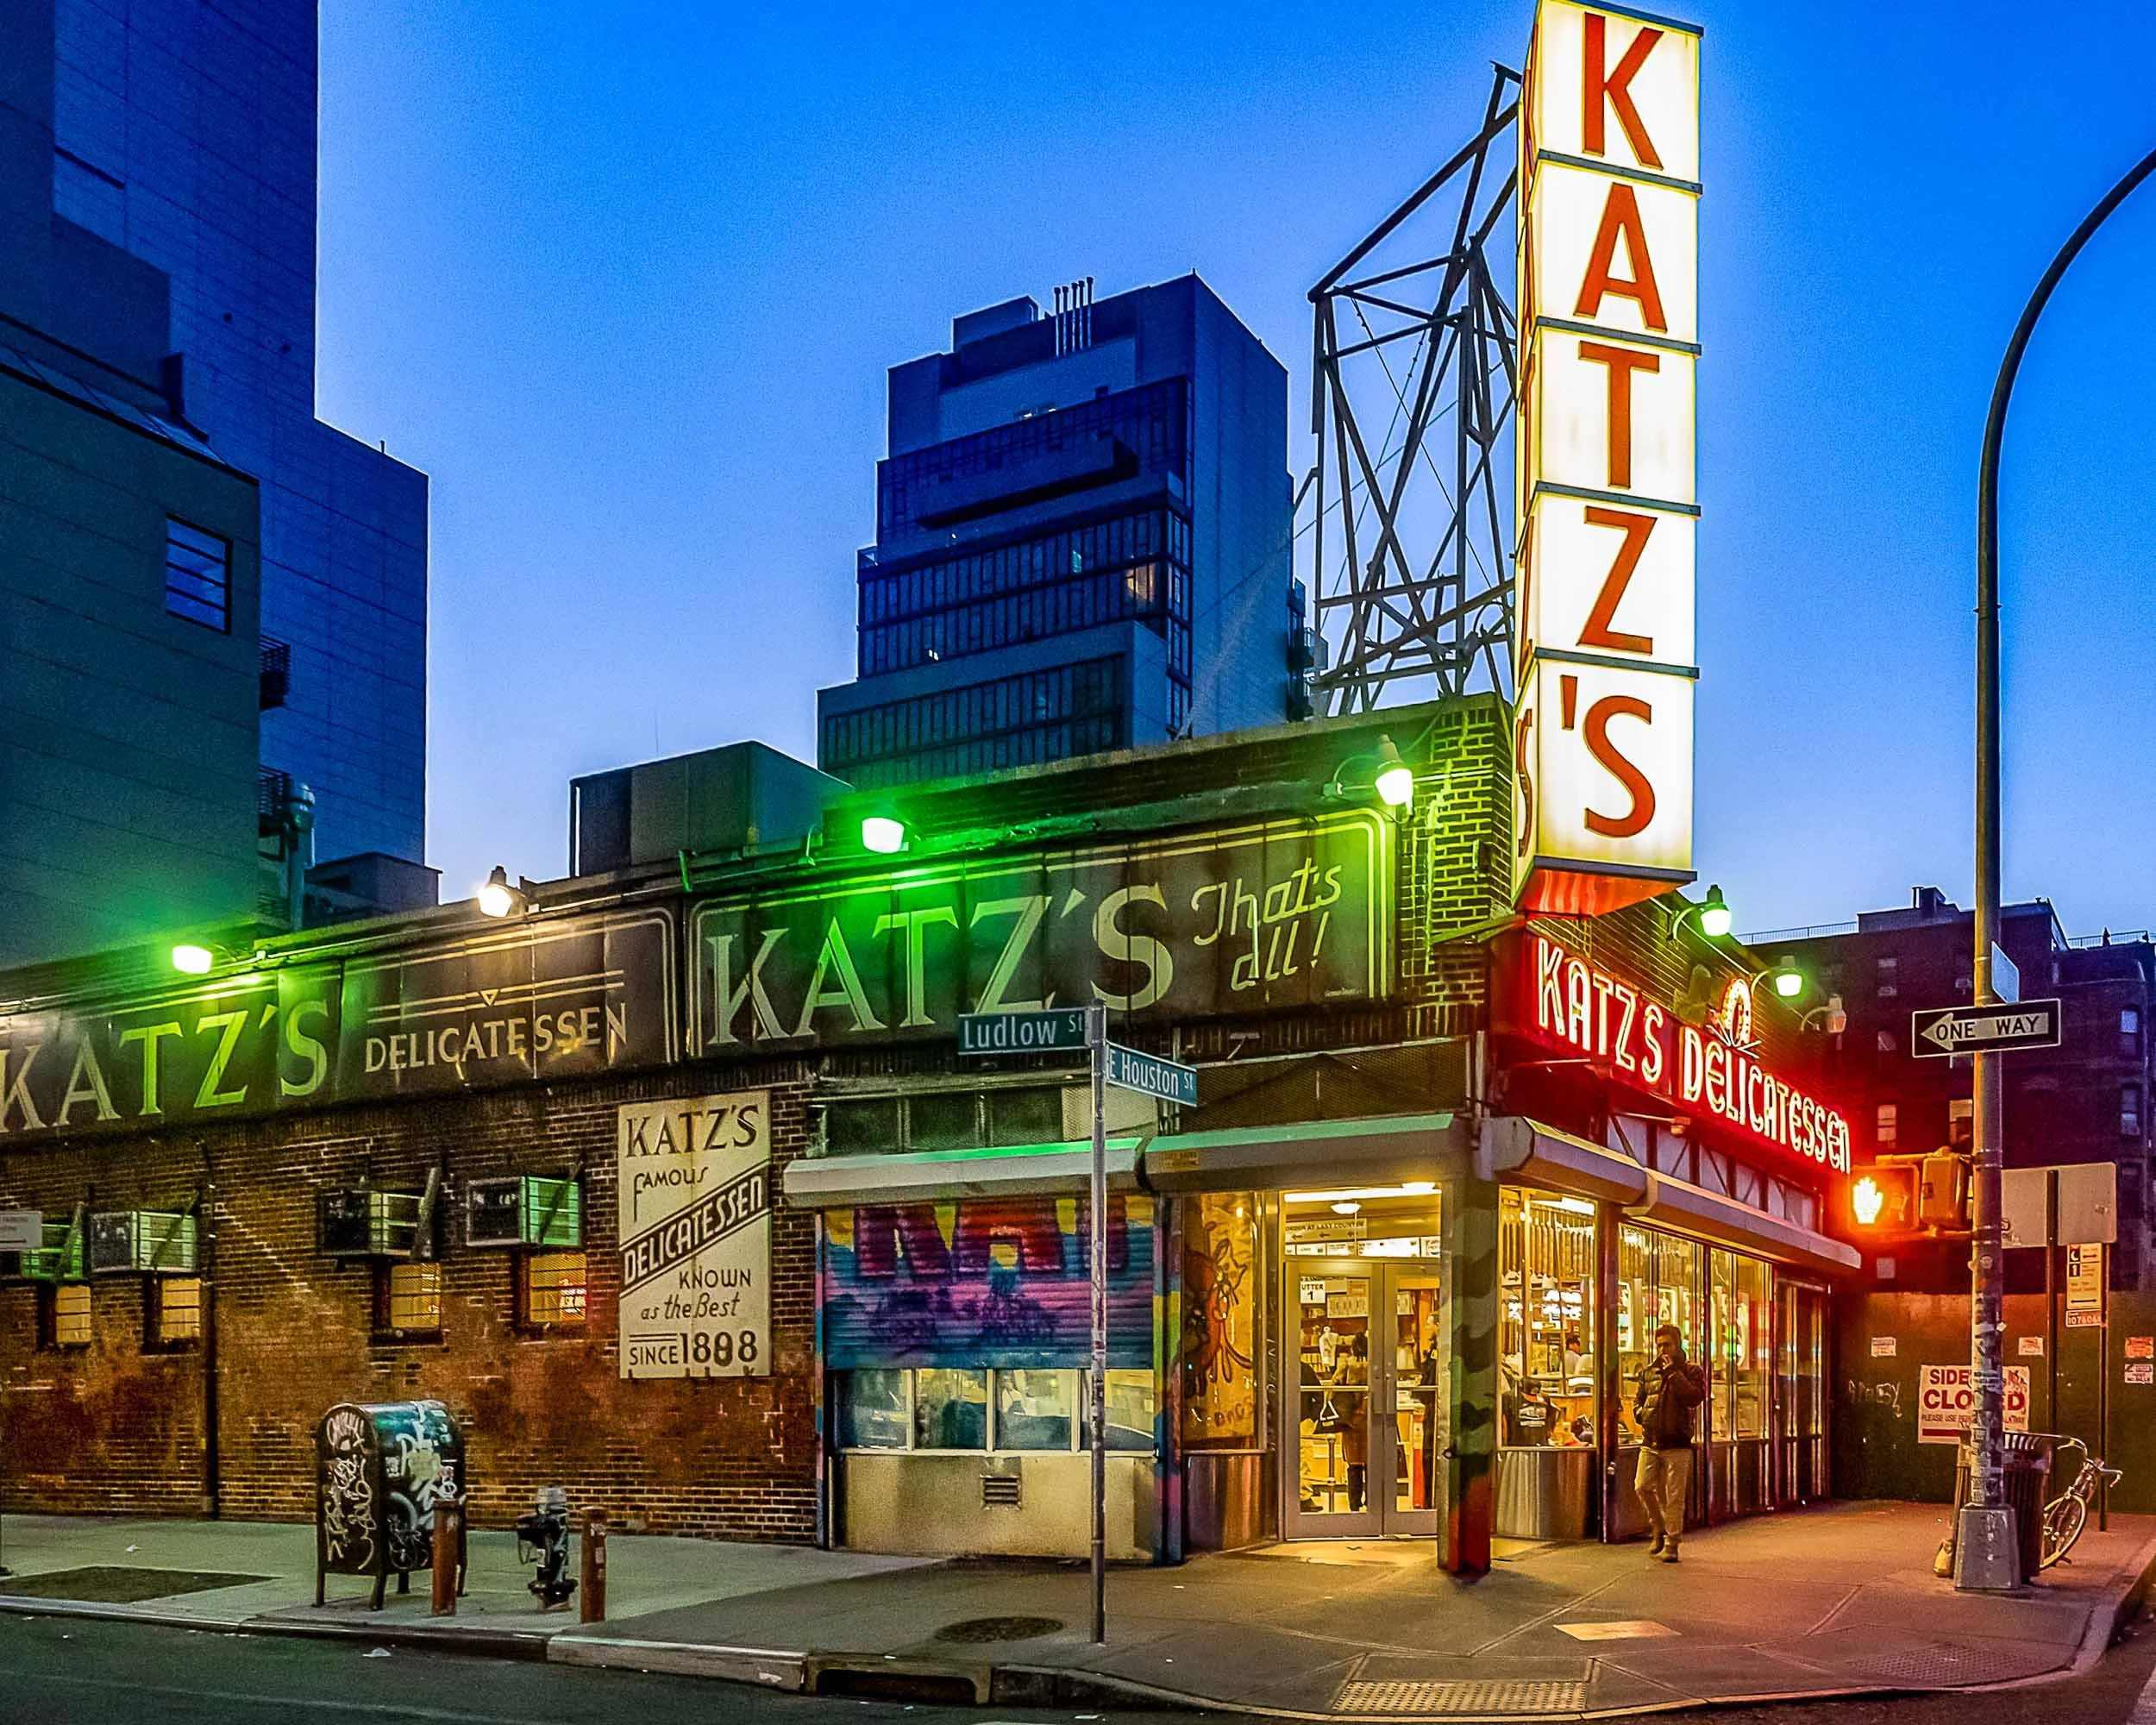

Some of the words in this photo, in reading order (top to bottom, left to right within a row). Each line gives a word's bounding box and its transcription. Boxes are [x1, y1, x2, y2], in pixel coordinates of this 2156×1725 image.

[1559, 12, 1669, 838] KATZ'S
[705, 881, 1174, 1044] KATZ'S
[365, 1002, 628, 1072] DELICATESSEN
[963, 1015, 1057, 1050] Ludlow
[1069, 1013, 1084, 1033] St
[1935, 1021, 1976, 1041] ONE
[1996, 1015, 2040, 1035] WAY
[0, 1000, 329, 1132] KATZ'S
[1122, 1052, 1179, 1096] Houston
[1183, 1071, 1194, 1091] St
[625, 1104, 760, 1158] KATZ'S
[680, 1269, 751, 1289] KNOWN
[641, 1305, 659, 1320] as
[663, 1295, 691, 1320] the
[693, 1292, 740, 1319] Best
[629, 1346, 680, 1366] SINCE
